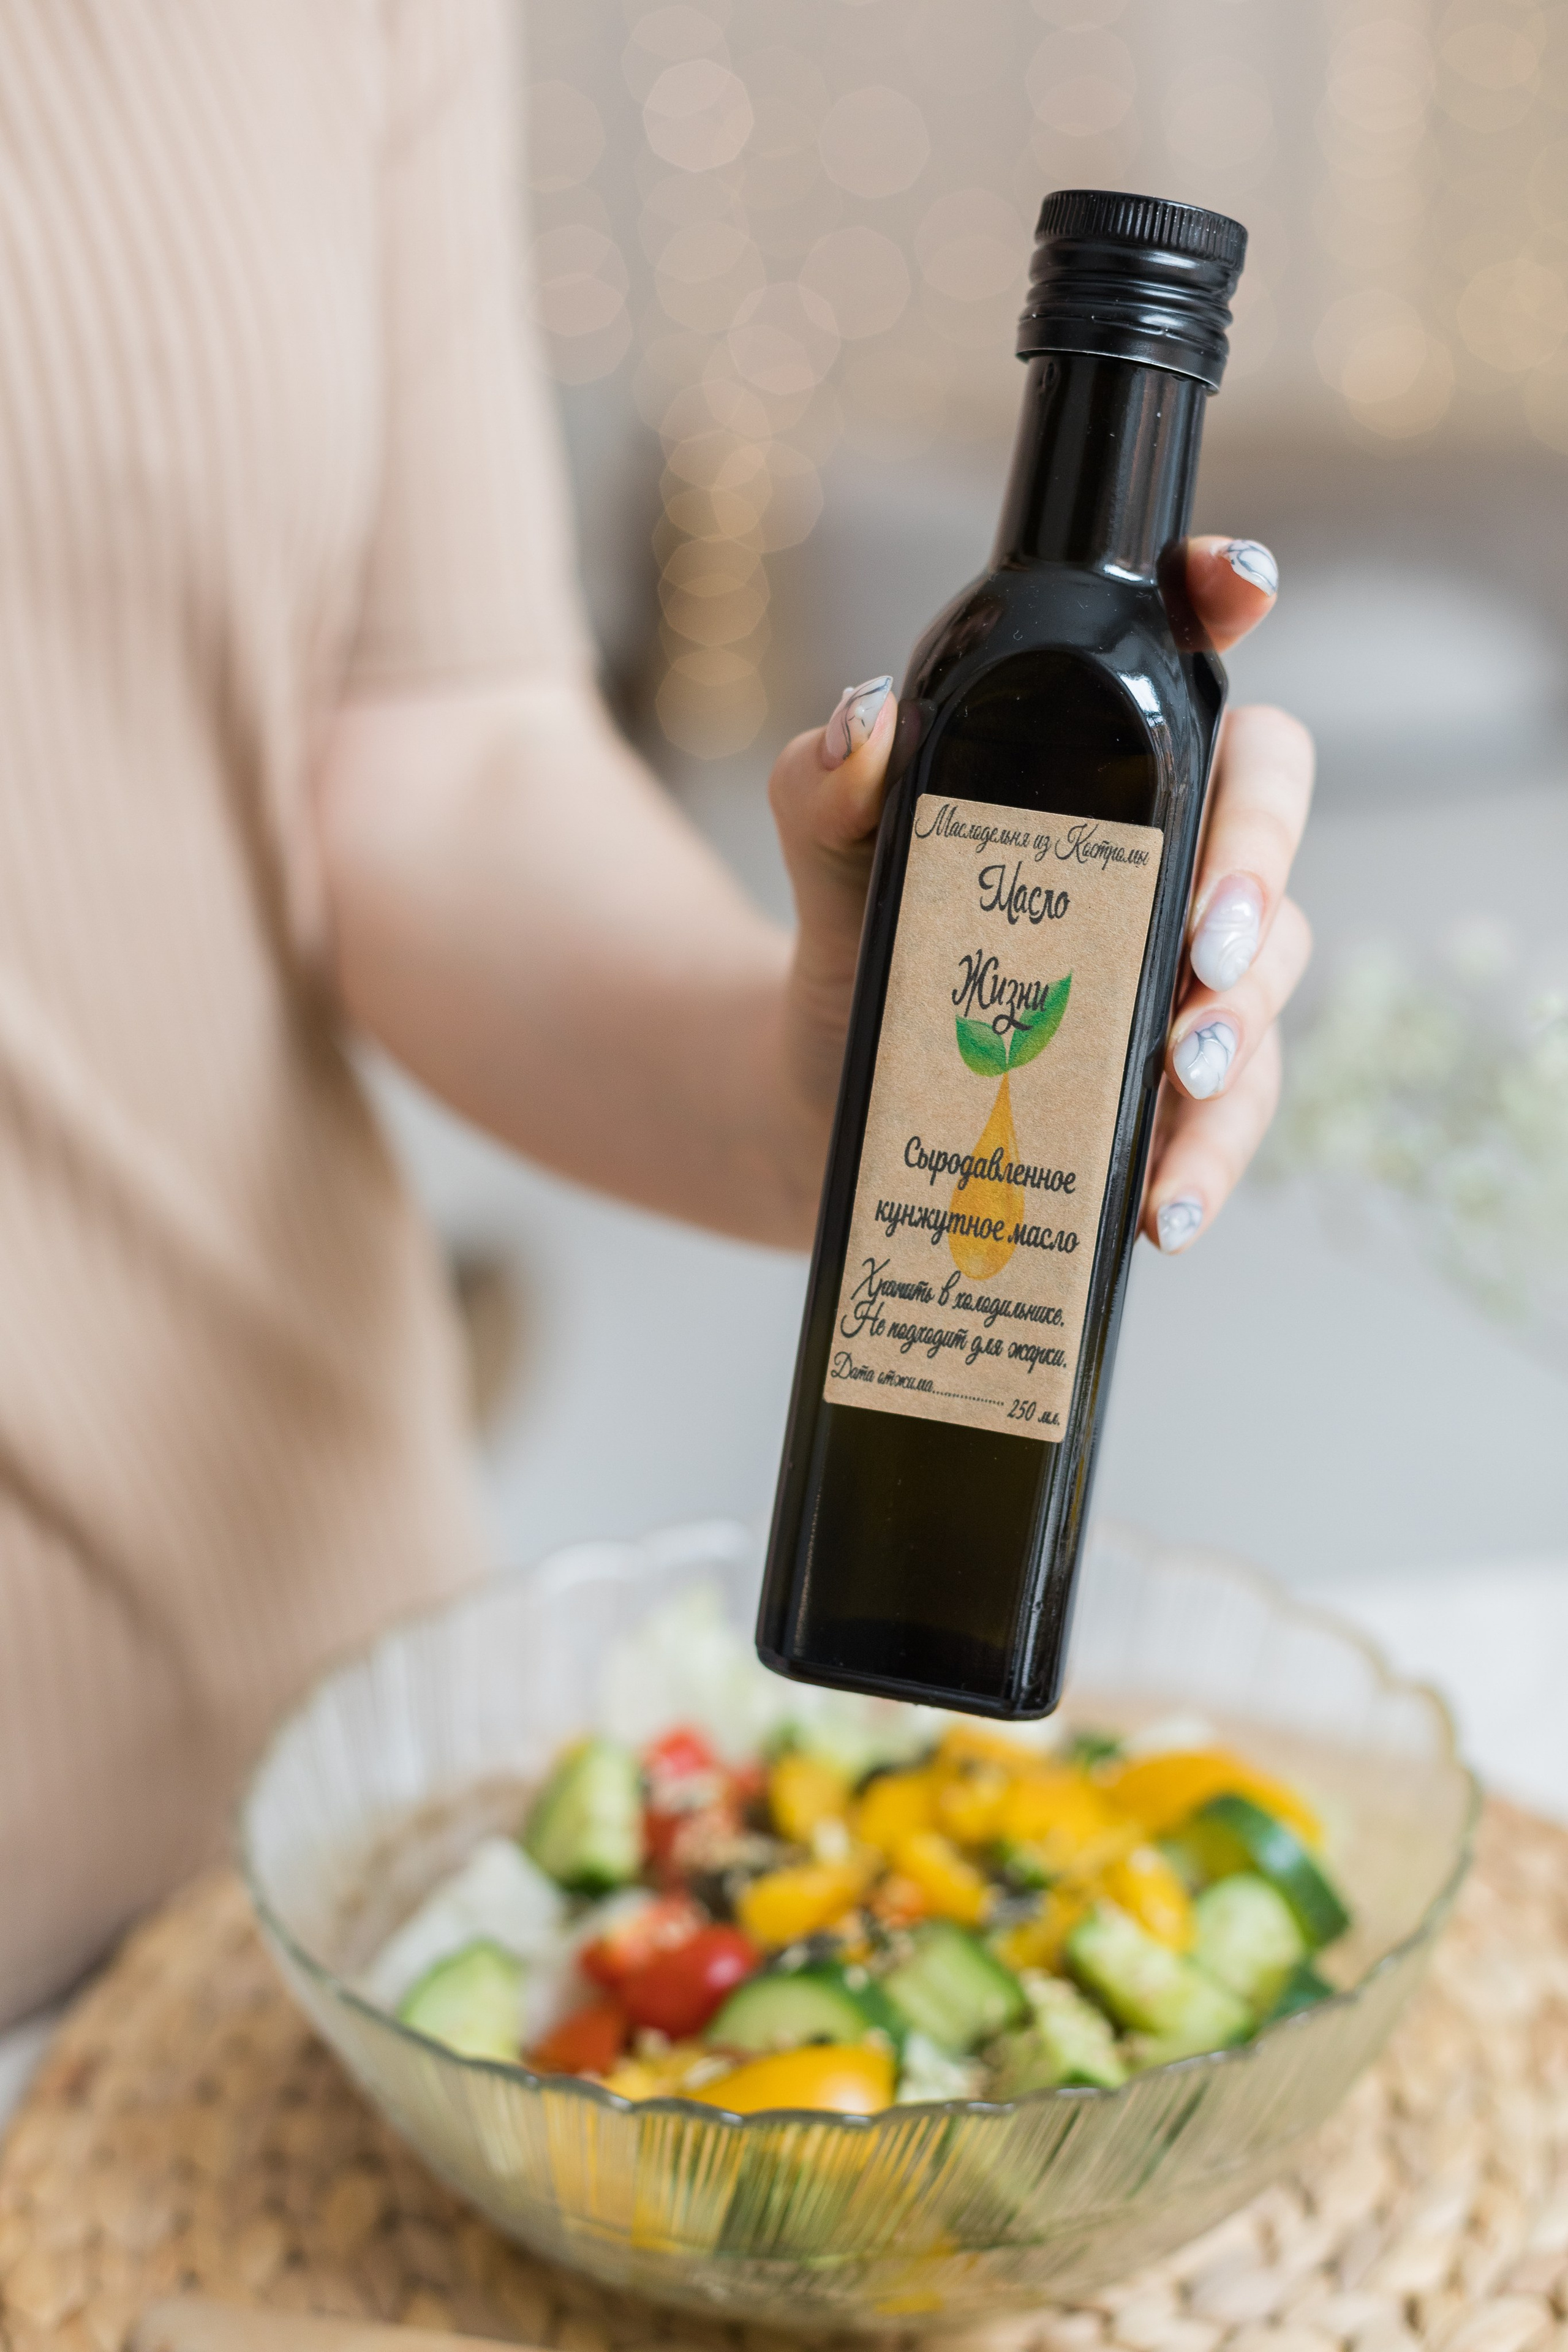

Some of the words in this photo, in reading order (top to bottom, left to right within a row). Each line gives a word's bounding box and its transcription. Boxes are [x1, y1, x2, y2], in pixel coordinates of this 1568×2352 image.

[1032, 836, 1052, 862] из
[1054, 824, 1150, 870] Костромы
[978, 861, 1071, 925] Масло
[952, 949, 1049, 1035] Жизни
[904, 1136, 1076, 1194] Сыродавленное
[875, 1200, 1005, 1245] кунжутное
[1008, 1221, 1080, 1253] масло
[851, 1257, 935, 1303] Хранить
[938, 1270, 961, 1306] в
[952, 1291, 1065, 1328] холодильнике.
[840, 1300, 885, 1338] Не
[887, 1320, 967, 1359] подходит
[965, 1335, 1003, 1365] для
[1008, 1341, 1068, 1374] жарки.
[831, 1351, 875, 1379] Дата
[1007, 1398, 1037, 1422] 250
[1038, 1409, 1061, 1426] мл.
